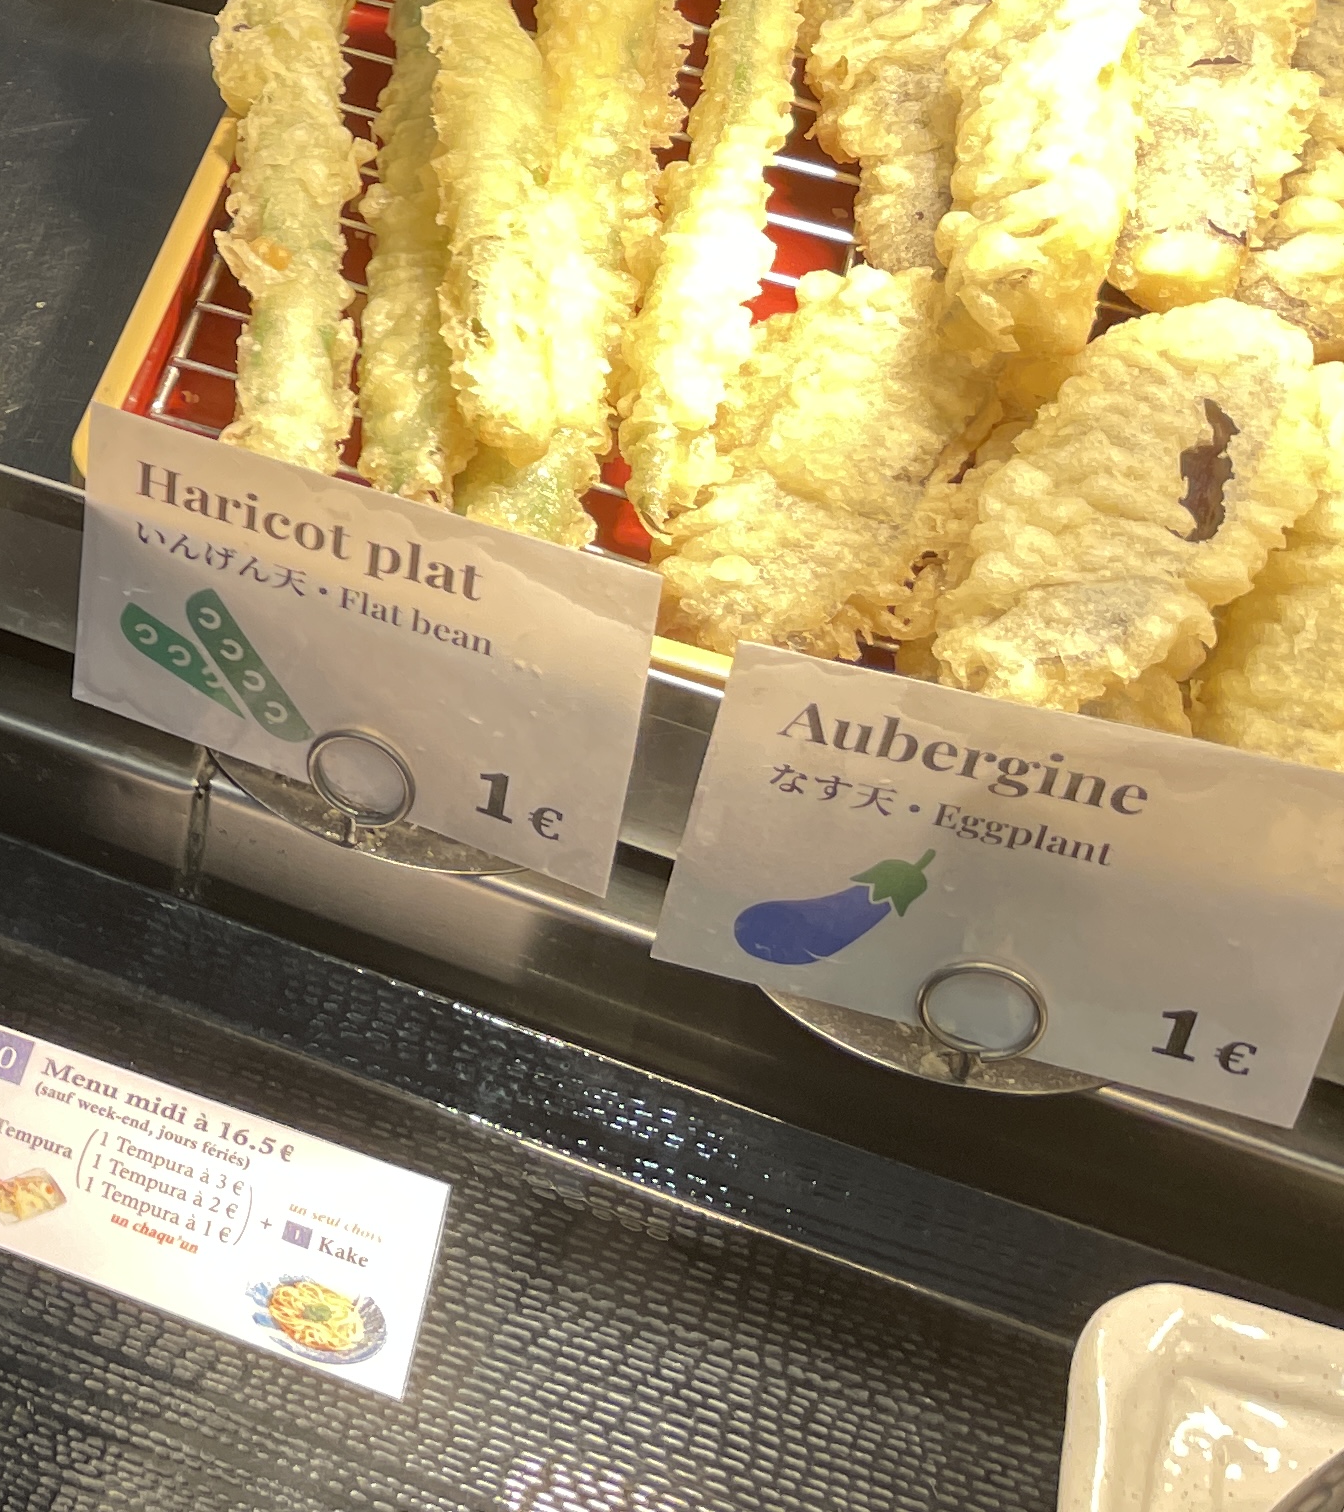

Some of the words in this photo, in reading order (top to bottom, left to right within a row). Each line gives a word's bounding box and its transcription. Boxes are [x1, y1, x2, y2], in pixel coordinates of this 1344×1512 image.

[136, 459, 350, 561] Haricot
[363, 539, 483, 602] plat
[136, 520, 309, 597] いんげん天
[340, 585, 403, 628] Flat
[412, 607, 493, 657] bean
[770, 763, 899, 817] なす天
[776, 702, 1149, 816] Aubergine
[475, 770, 514, 827] 1
[527, 802, 566, 845] €
[932, 801, 1115, 867] Eggplant
[1151, 1009, 1198, 1064] 1
[1216, 1037, 1259, 1079] €
[35, 1081, 76, 1105] (sauf
[77, 1096, 154, 1136] week-end,
[155, 1126, 198, 1150] jours
[201, 1142, 251, 1171] fériés)
[40, 1056, 118, 1100] Menu
[124, 1091, 187, 1125] midi
[193, 1113, 208, 1133] à
[92, 1154, 103, 1170] 1
[109, 1157, 187, 1202] Tempura
[192, 1190, 203, 1207] à
[209, 1197, 220, 1213] 2
[225, 1203, 239, 1220] €
[99, 1131, 109, 1147] 1
[116, 1135, 194, 1179] Tempura
[199, 1167, 210, 1184] à
[216, 1173, 227, 1189] 3
[232, 1180, 245, 1196] €
[85, 1176, 94, 1192] 1
[101, 1180, 180, 1226] Tempura
[185, 1213, 196, 1231] à
[203, 1220, 212, 1236] 1
[219, 1226, 232, 1243] €
[110, 1213, 130, 1229] un
[312, 1209, 341, 1228] seul
[318, 1235, 369, 1268] Kake
